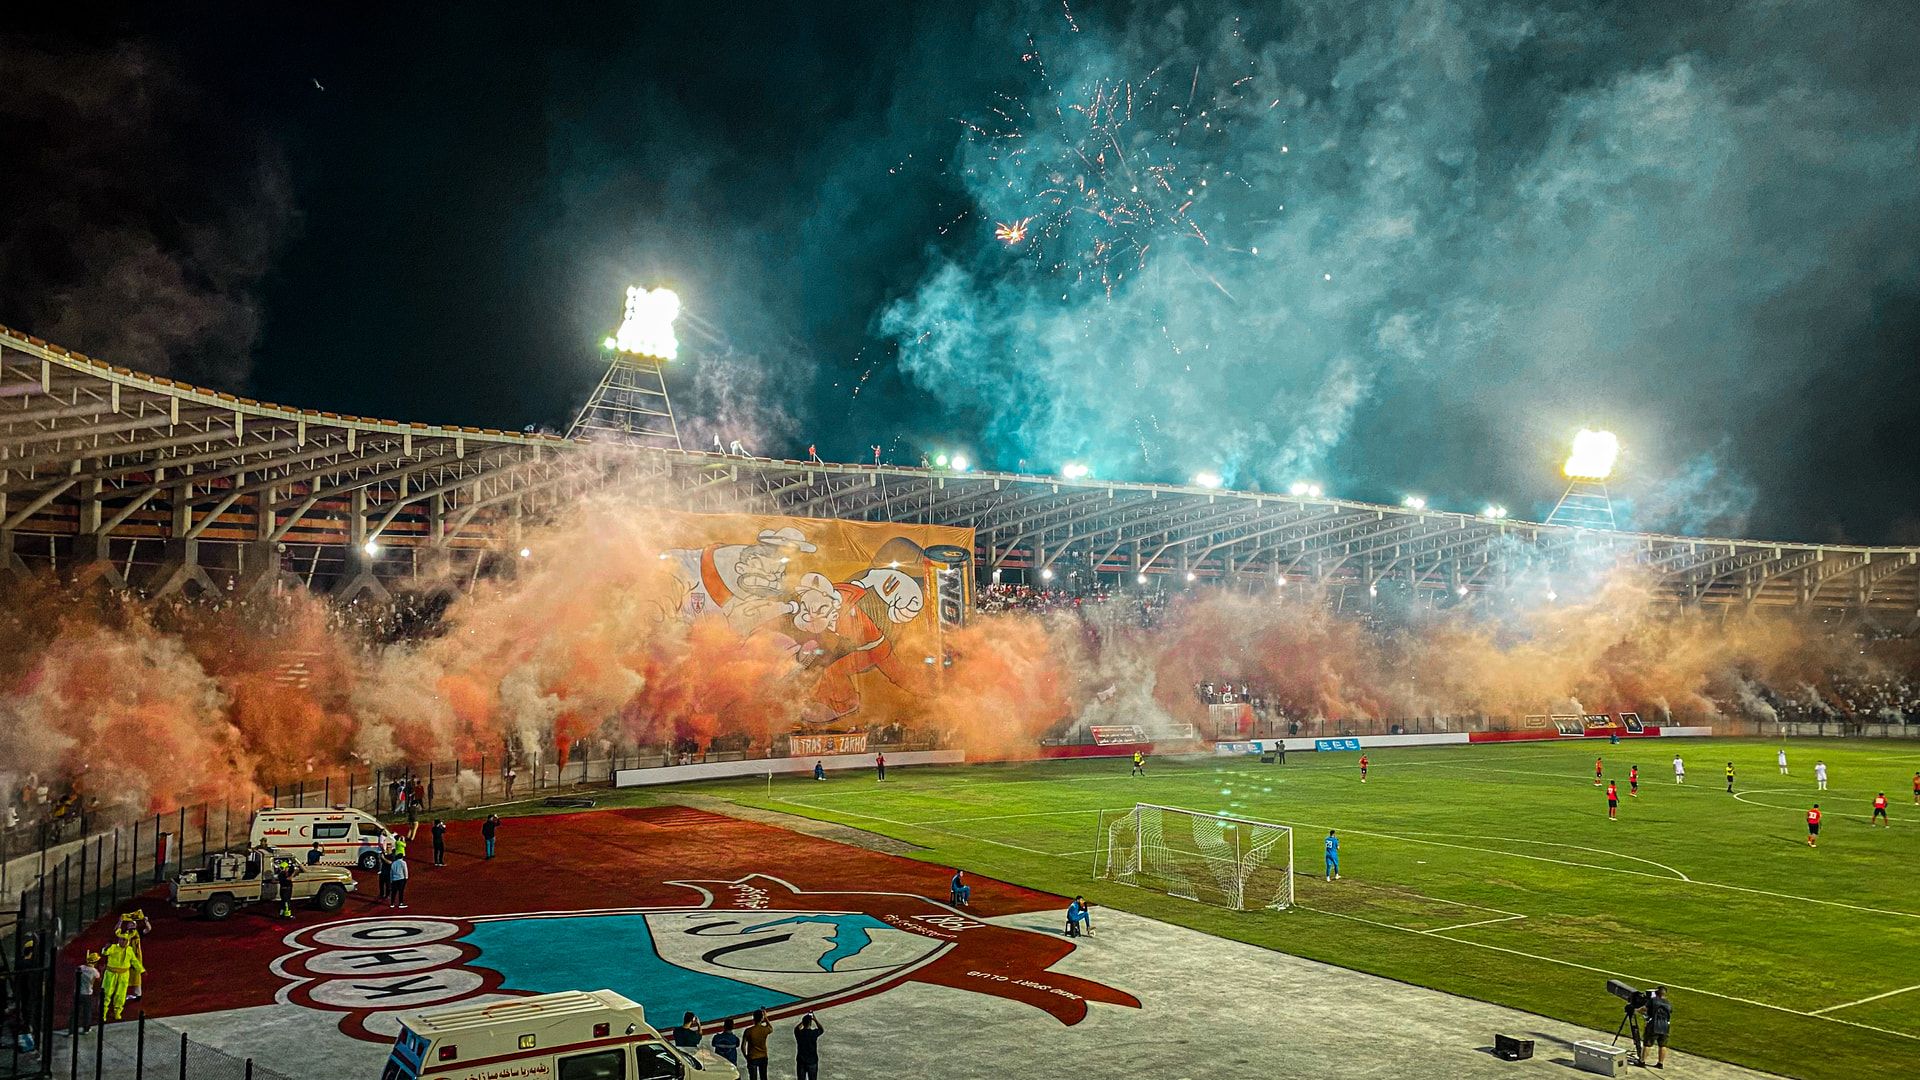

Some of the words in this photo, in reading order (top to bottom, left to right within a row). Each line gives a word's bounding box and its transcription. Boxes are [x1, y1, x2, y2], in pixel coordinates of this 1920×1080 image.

[790, 738, 821, 755] ULTRAS
[840, 736, 866, 753] ZAKHO
[966, 970, 1009, 982] CLUB
